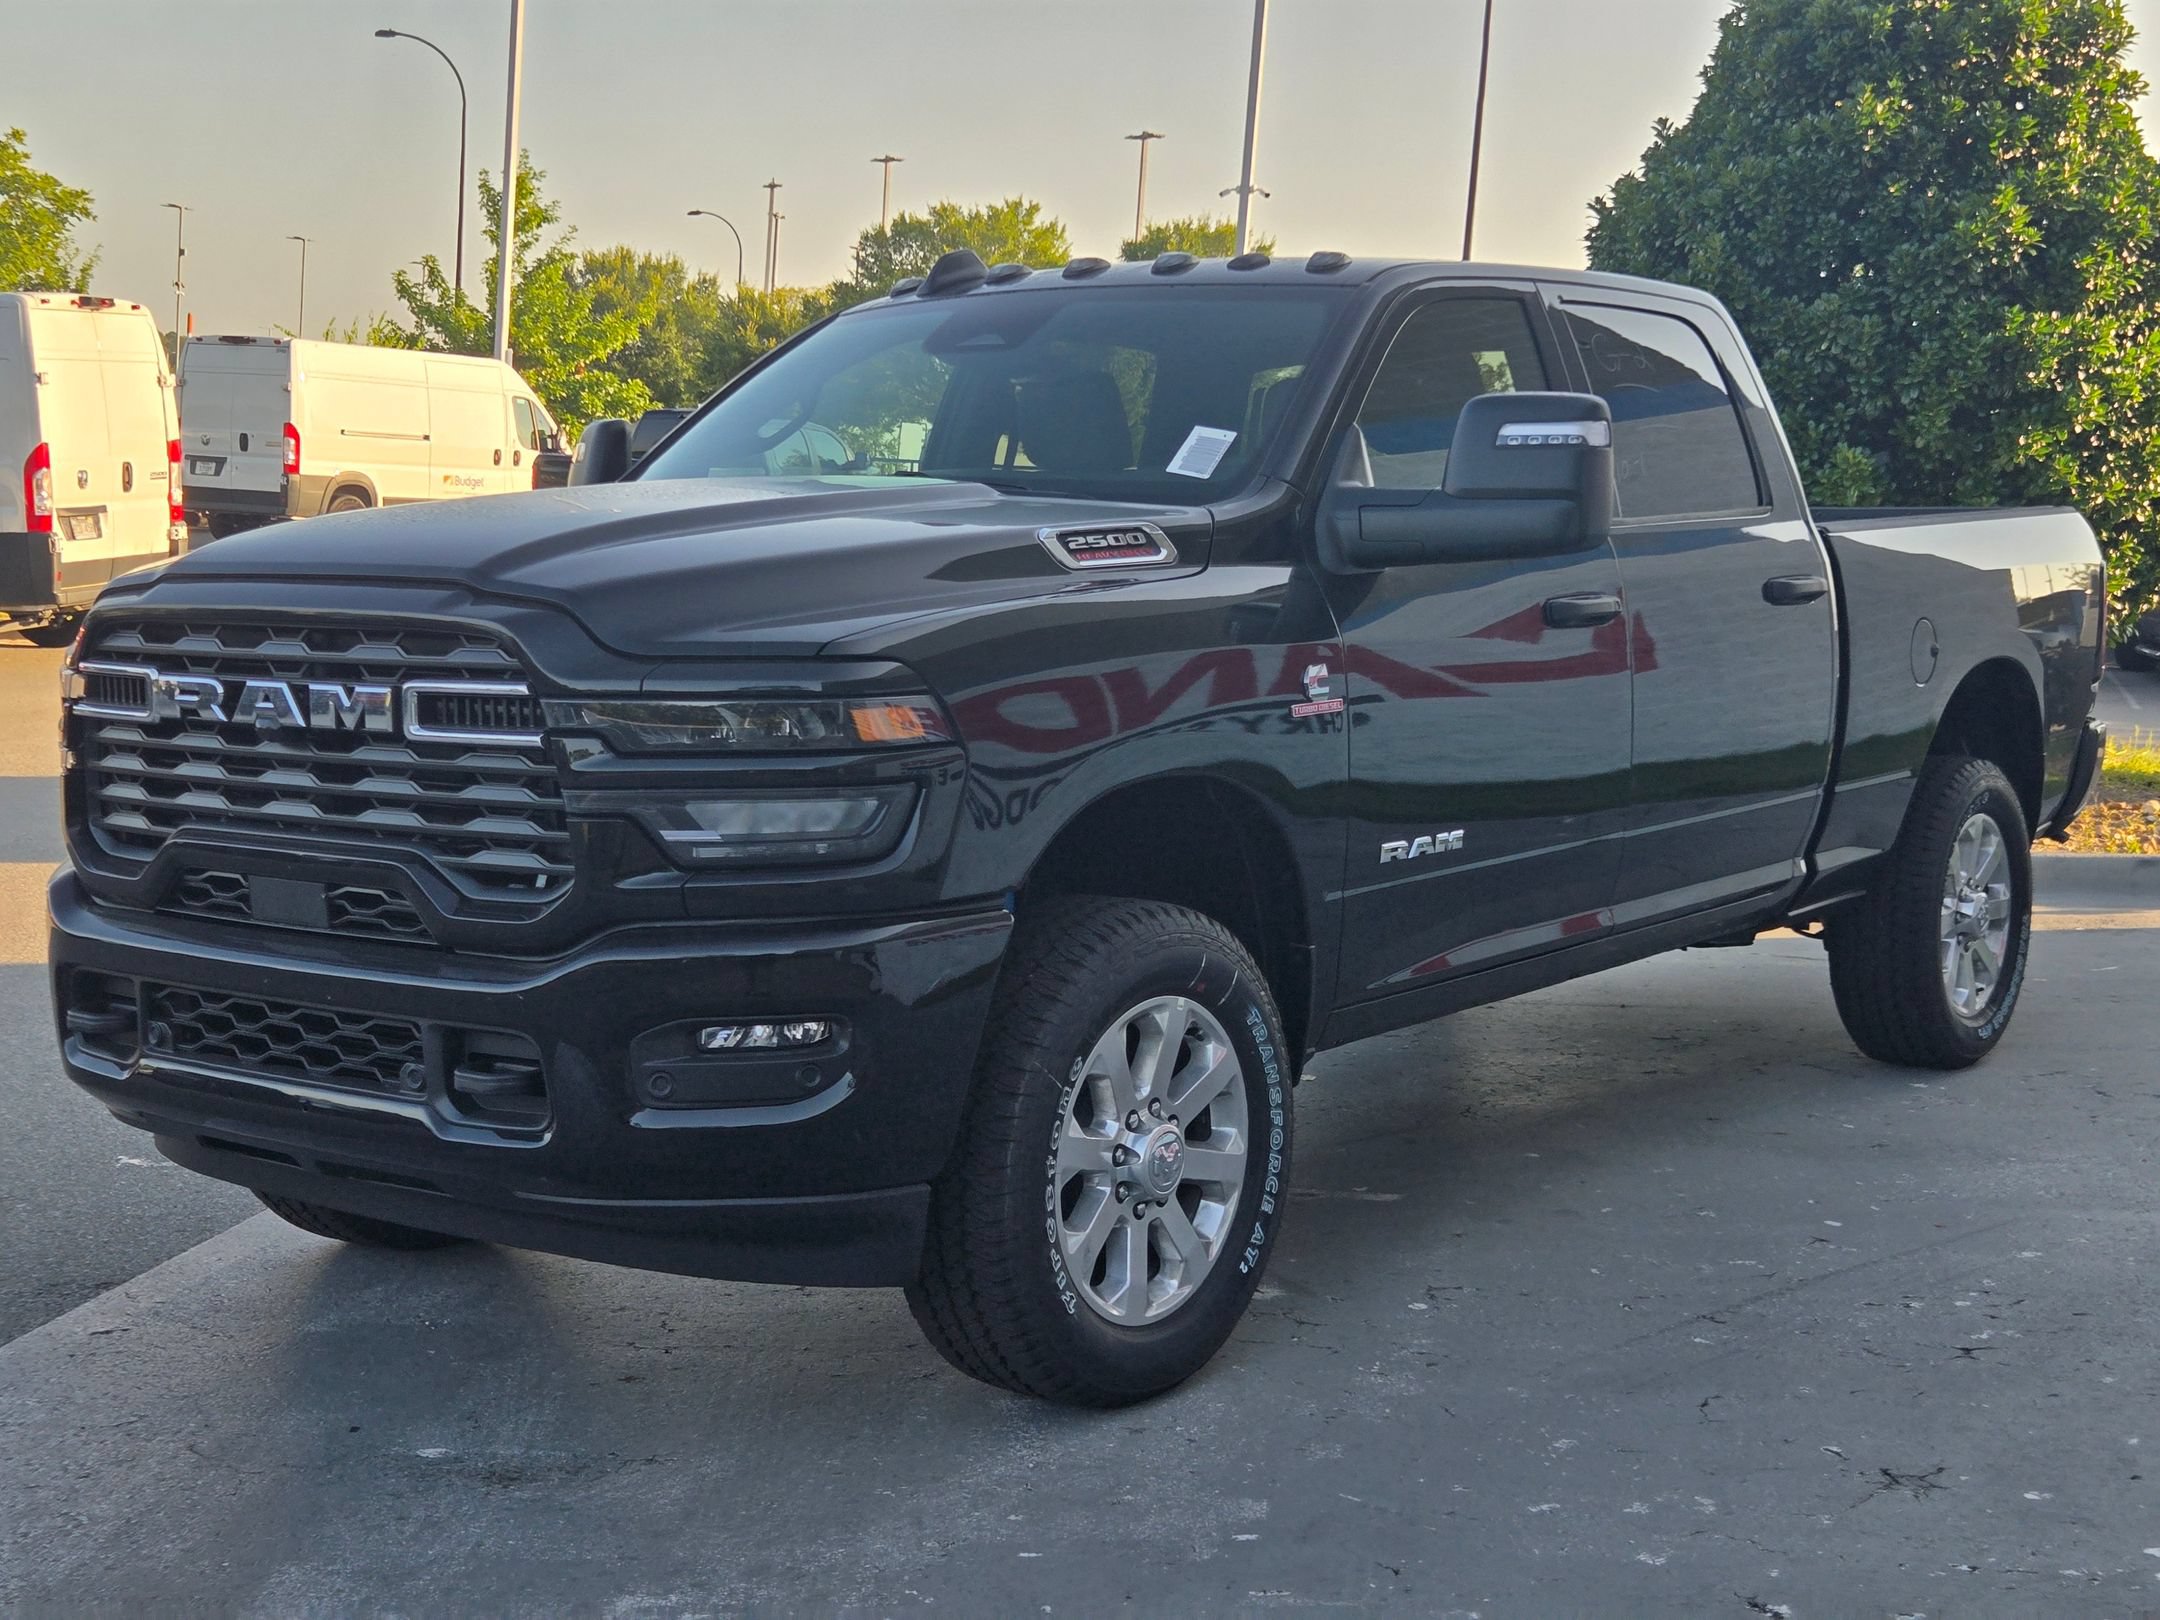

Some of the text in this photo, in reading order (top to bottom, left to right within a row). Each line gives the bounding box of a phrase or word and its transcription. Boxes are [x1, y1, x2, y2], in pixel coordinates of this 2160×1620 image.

[455, 475, 484, 490] Budget
[1065, 532, 1147, 549] 2500
[157, 673, 393, 732] RAM
[1295, 701, 1342, 715] TURBO DIESEL
[1380, 829, 1464, 864] RAM
[1246, 1007, 1284, 1214] TRANSFORCE
